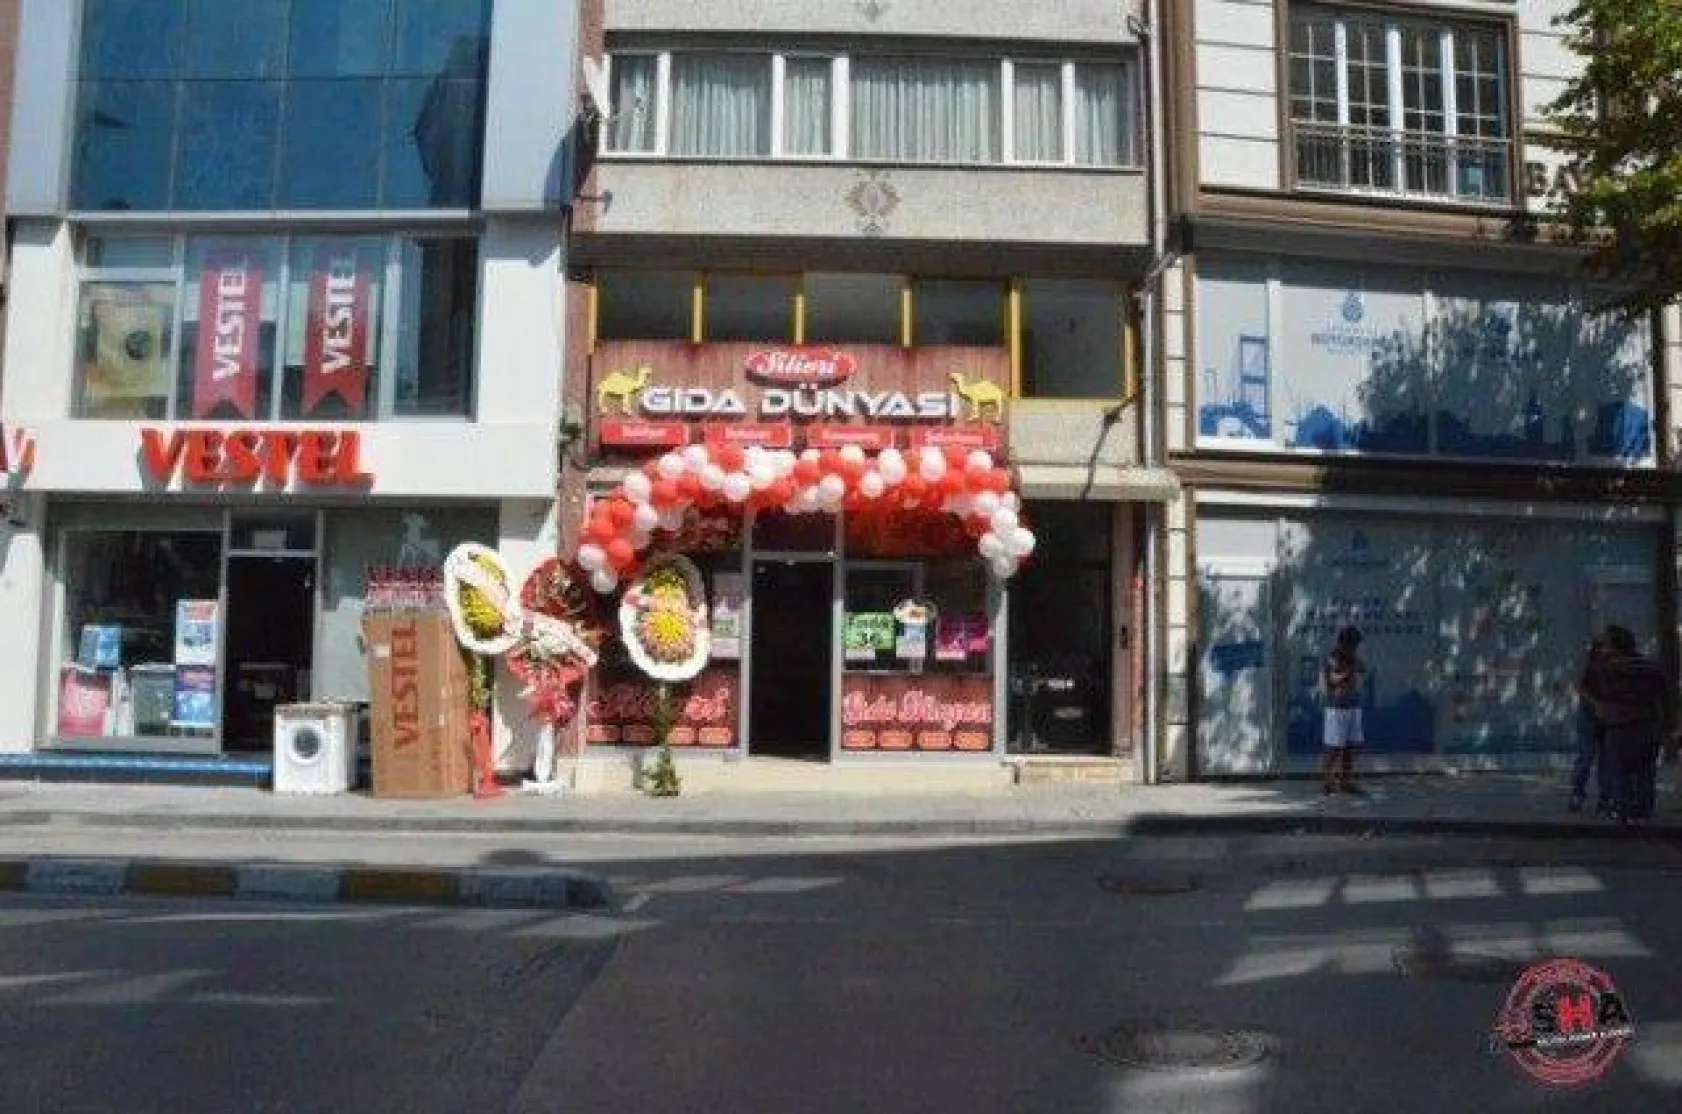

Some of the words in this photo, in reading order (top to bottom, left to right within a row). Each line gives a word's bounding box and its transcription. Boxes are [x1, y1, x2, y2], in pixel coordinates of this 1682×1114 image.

[643, 387, 747, 413] GIDA
[760, 382, 958, 416] DÜNYASI
[138, 427, 375, 488] VESTEL
[390, 616, 420, 750] VESTEL
